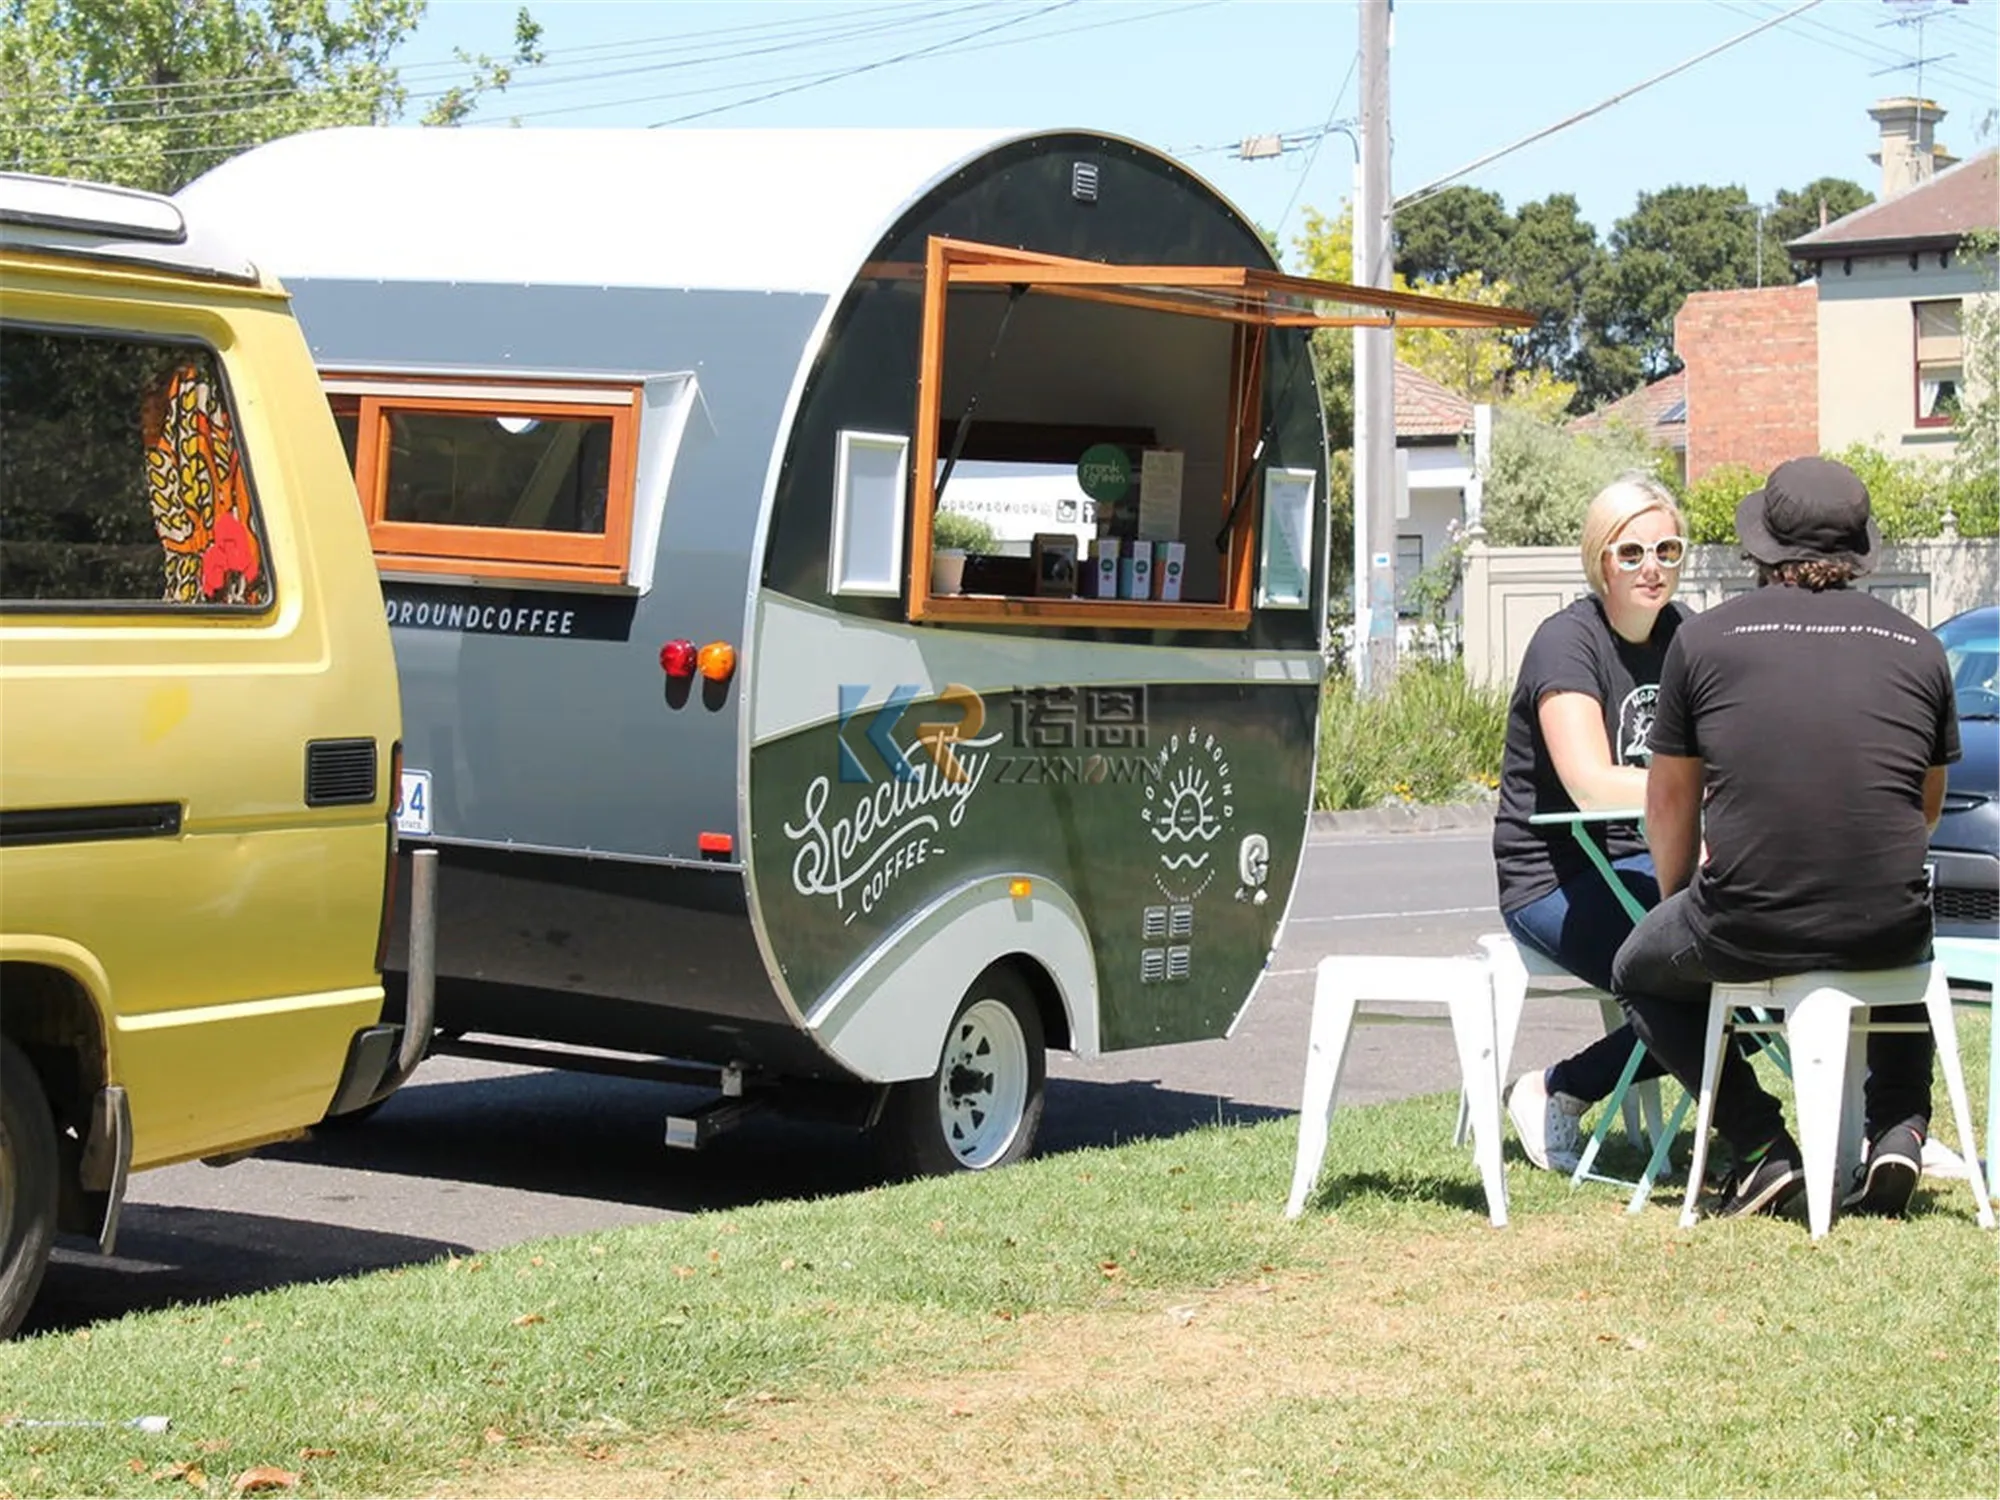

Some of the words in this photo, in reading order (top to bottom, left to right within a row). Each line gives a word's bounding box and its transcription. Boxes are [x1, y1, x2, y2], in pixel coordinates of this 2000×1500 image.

[784, 726, 1004, 910] Specialty
[1204, 734, 1234, 818] ROUND
[861, 838, 930, 913] COFFEE
